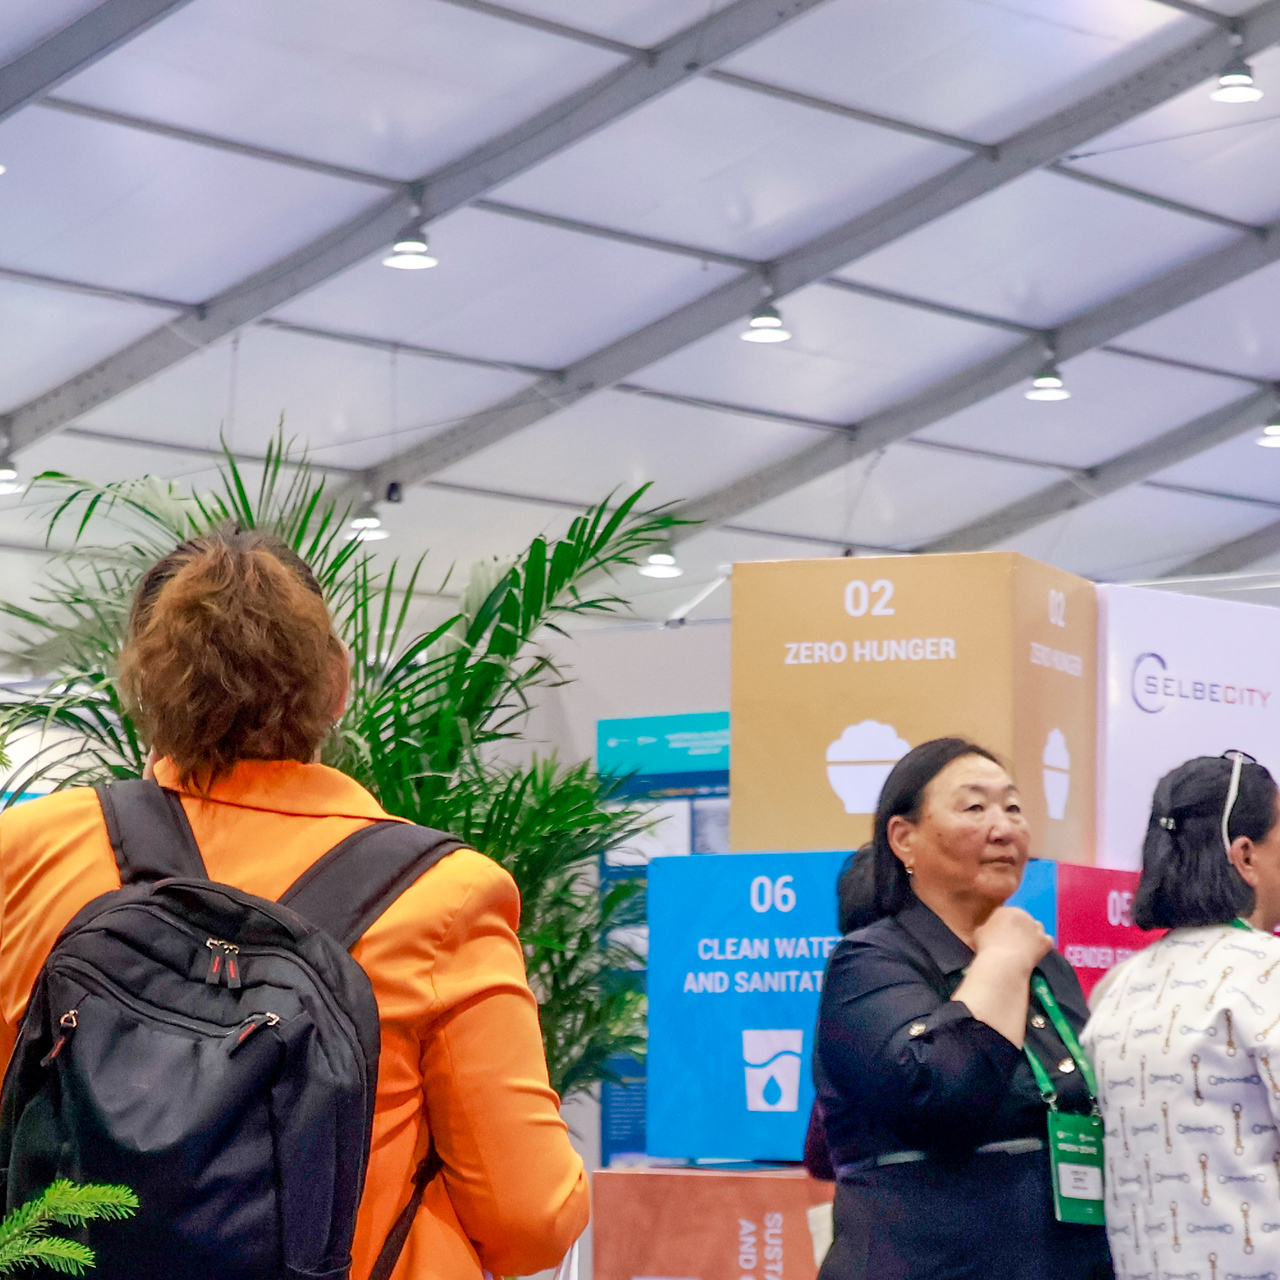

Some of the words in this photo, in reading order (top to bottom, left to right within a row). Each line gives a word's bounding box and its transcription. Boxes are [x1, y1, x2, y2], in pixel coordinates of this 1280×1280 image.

[843, 578, 896, 618] 02
[784, 641, 848, 665] ZERO
[852, 637, 957, 662] HUNGER
[750, 874, 797, 913] 06
[697, 937, 770, 961] CLEAN
[774, 935, 845, 960] WATE
[683, 971, 730, 994] AND
[734, 970, 824, 994] SANITAT
[738, 1218, 757, 1271] AND
